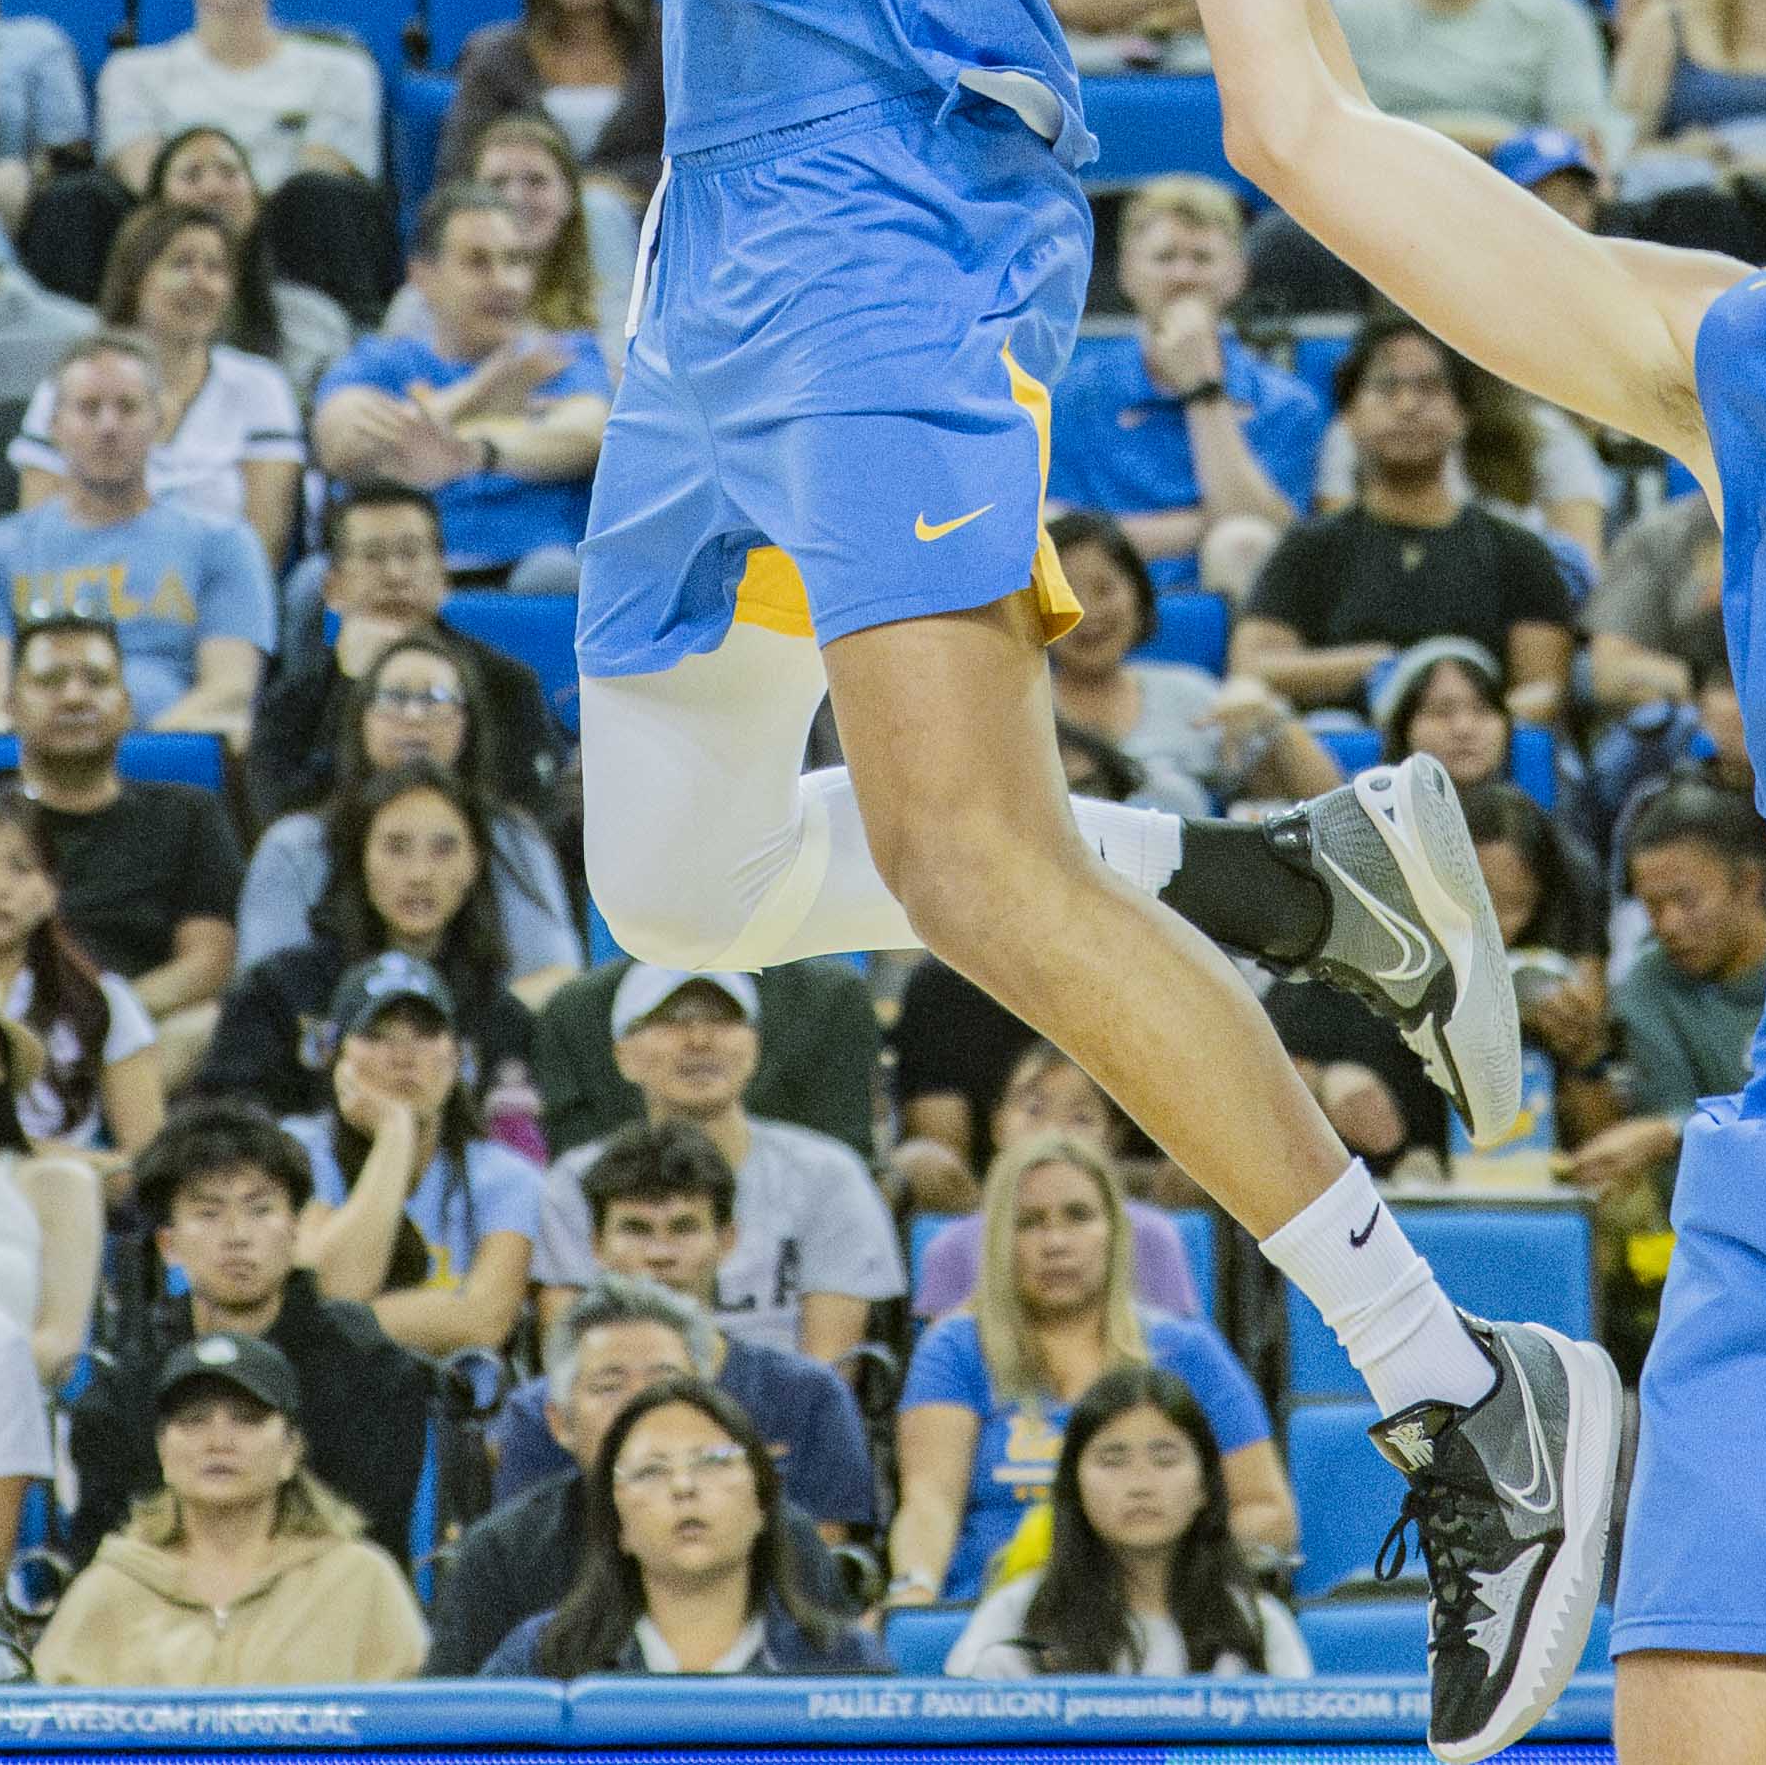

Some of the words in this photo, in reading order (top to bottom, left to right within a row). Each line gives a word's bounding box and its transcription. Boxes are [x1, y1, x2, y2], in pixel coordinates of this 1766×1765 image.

[13, 562, 199, 626] UCLA
[808, 1690, 912, 1719] PAULEY
[922, 1689, 1057, 1717] PAVILION
[1065, 1688, 1202, 1725] presented
[1209, 1688, 1247, 1725] by
[1254, 1689, 1392, 1718] WESCOM
